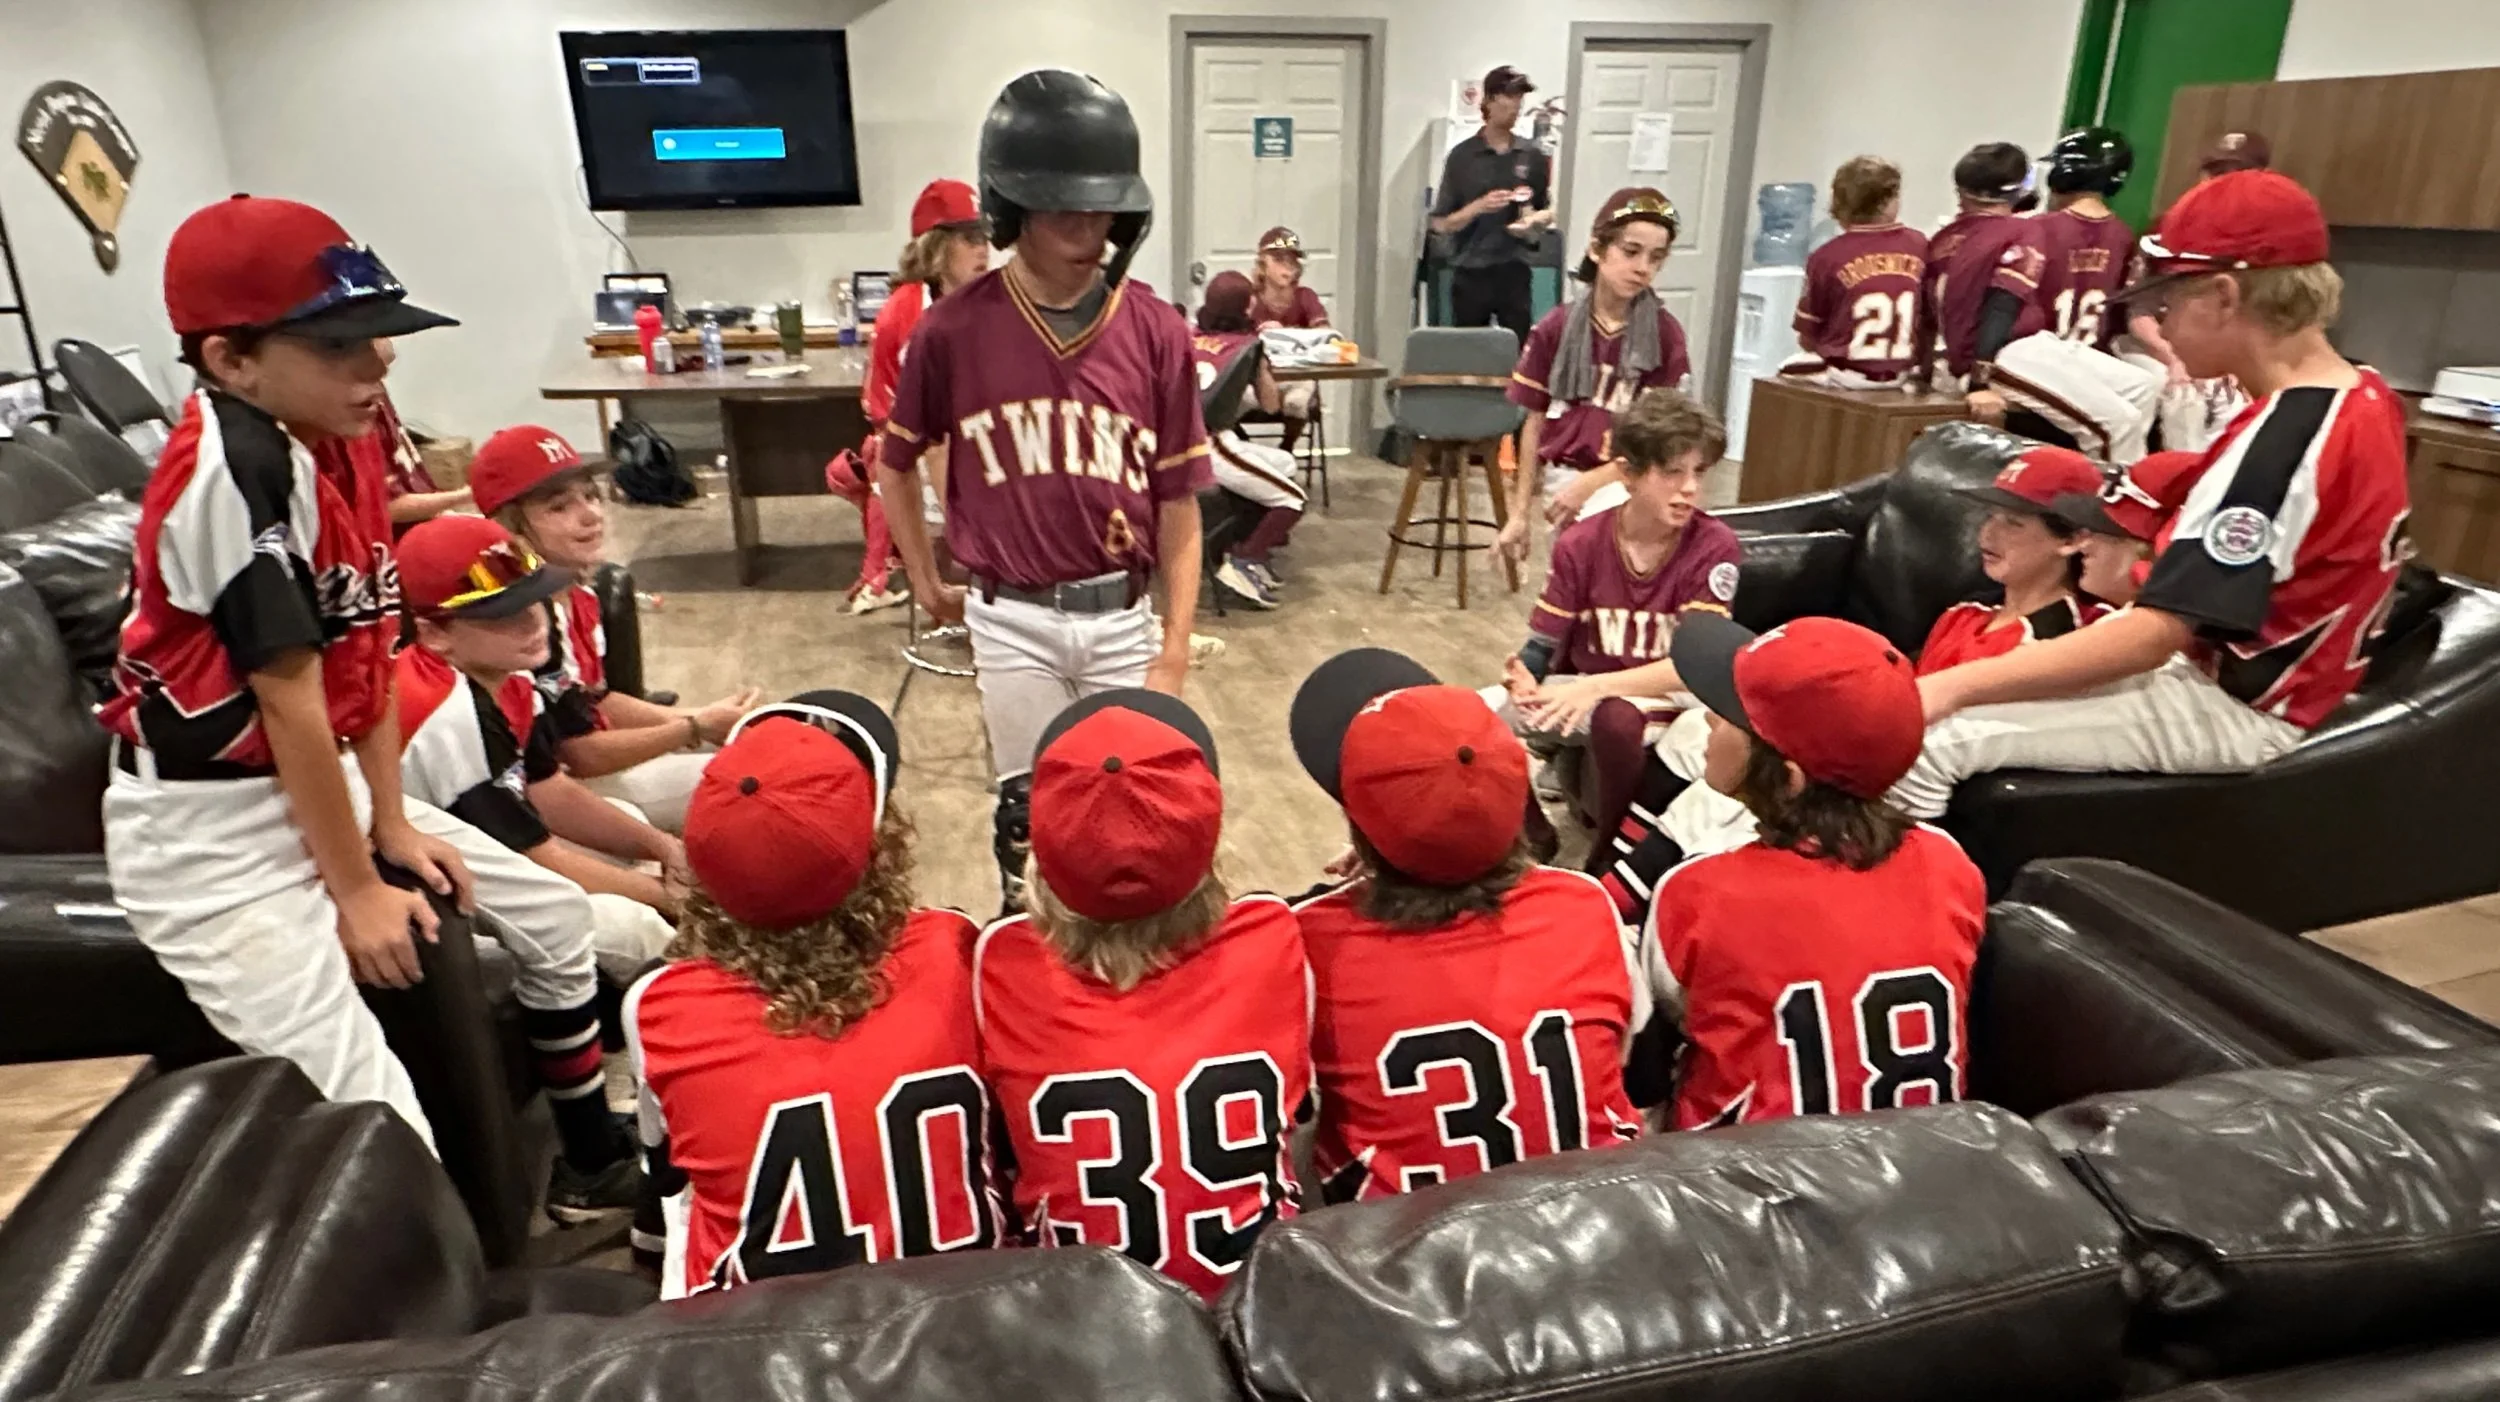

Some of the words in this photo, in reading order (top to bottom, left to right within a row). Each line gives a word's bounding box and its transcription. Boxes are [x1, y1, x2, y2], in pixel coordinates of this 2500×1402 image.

[1848, 291, 1915, 360] 21
[959, 398, 1158, 494] TWINS
[1579, 607, 1680, 659] WIN
[1377, 1009, 1590, 1193] 31
[1775, 965, 1960, 1116] 18
[735, 1064, 990, 1284] 40
[1029, 1050, 1287, 1275] 39
